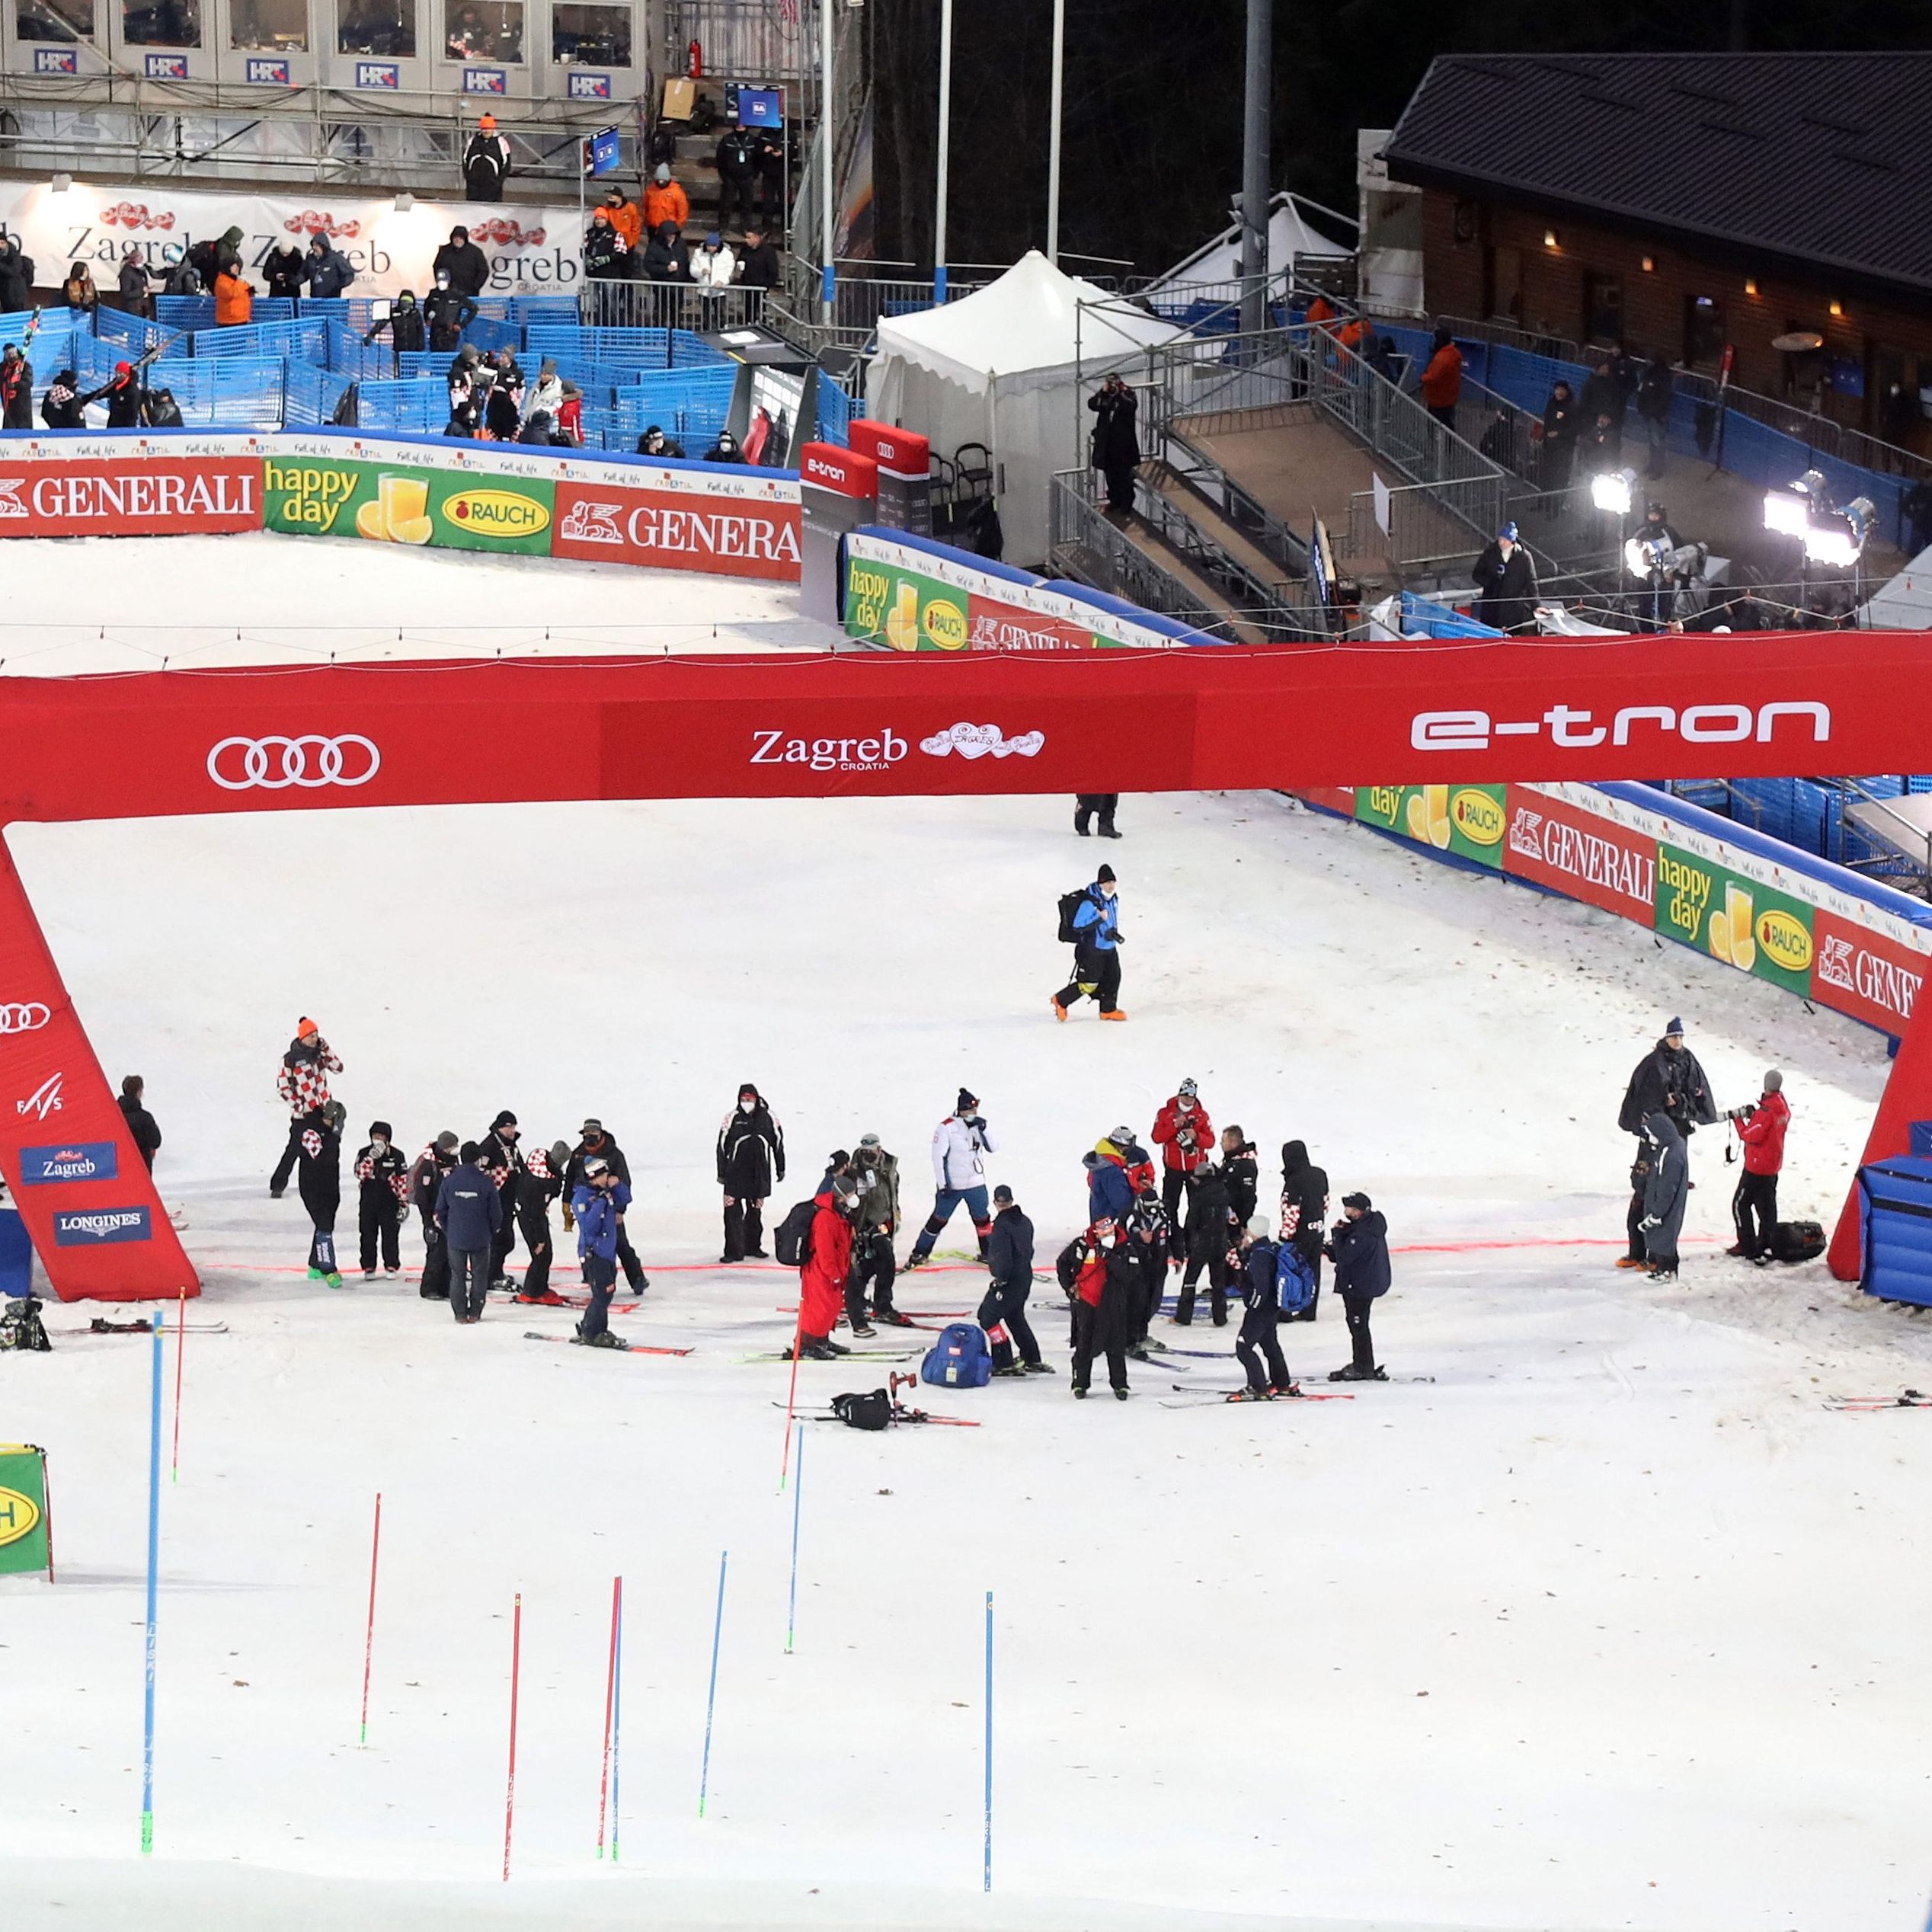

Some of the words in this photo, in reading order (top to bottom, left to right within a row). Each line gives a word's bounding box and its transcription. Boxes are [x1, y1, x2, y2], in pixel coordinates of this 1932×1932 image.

[490, 247, 577, 289] greb
[265, 460, 359, 503] happy
[808, 458, 846, 482] e-tron
[33, 474, 255, 517] GENERALI
[283, 494, 339, 531] day
[472, 500, 536, 526] RAUCH
[628, 507, 801, 562] GENERA
[849, 561, 889, 608] happy
[857, 597, 881, 637] day
[935, 613, 963, 638] RAUCH
[1410, 701, 1831, 751] e-tron
[750, 728, 908, 771] Zagreb
[840, 763, 889, 771] CROATIA
[1465, 805, 1499, 833] RAUCH
[1543, 820, 1655, 906] GENERALI
[1659, 846, 1711, 910] happy
[1670, 891, 1702, 942] day
[1771, 927, 1806, 959] RAUCH
[1855, 949, 1923, 1019] GENE
[43, 1158, 95, 1179] Zagreb
[60, 1212, 142, 1230] LONGINES
